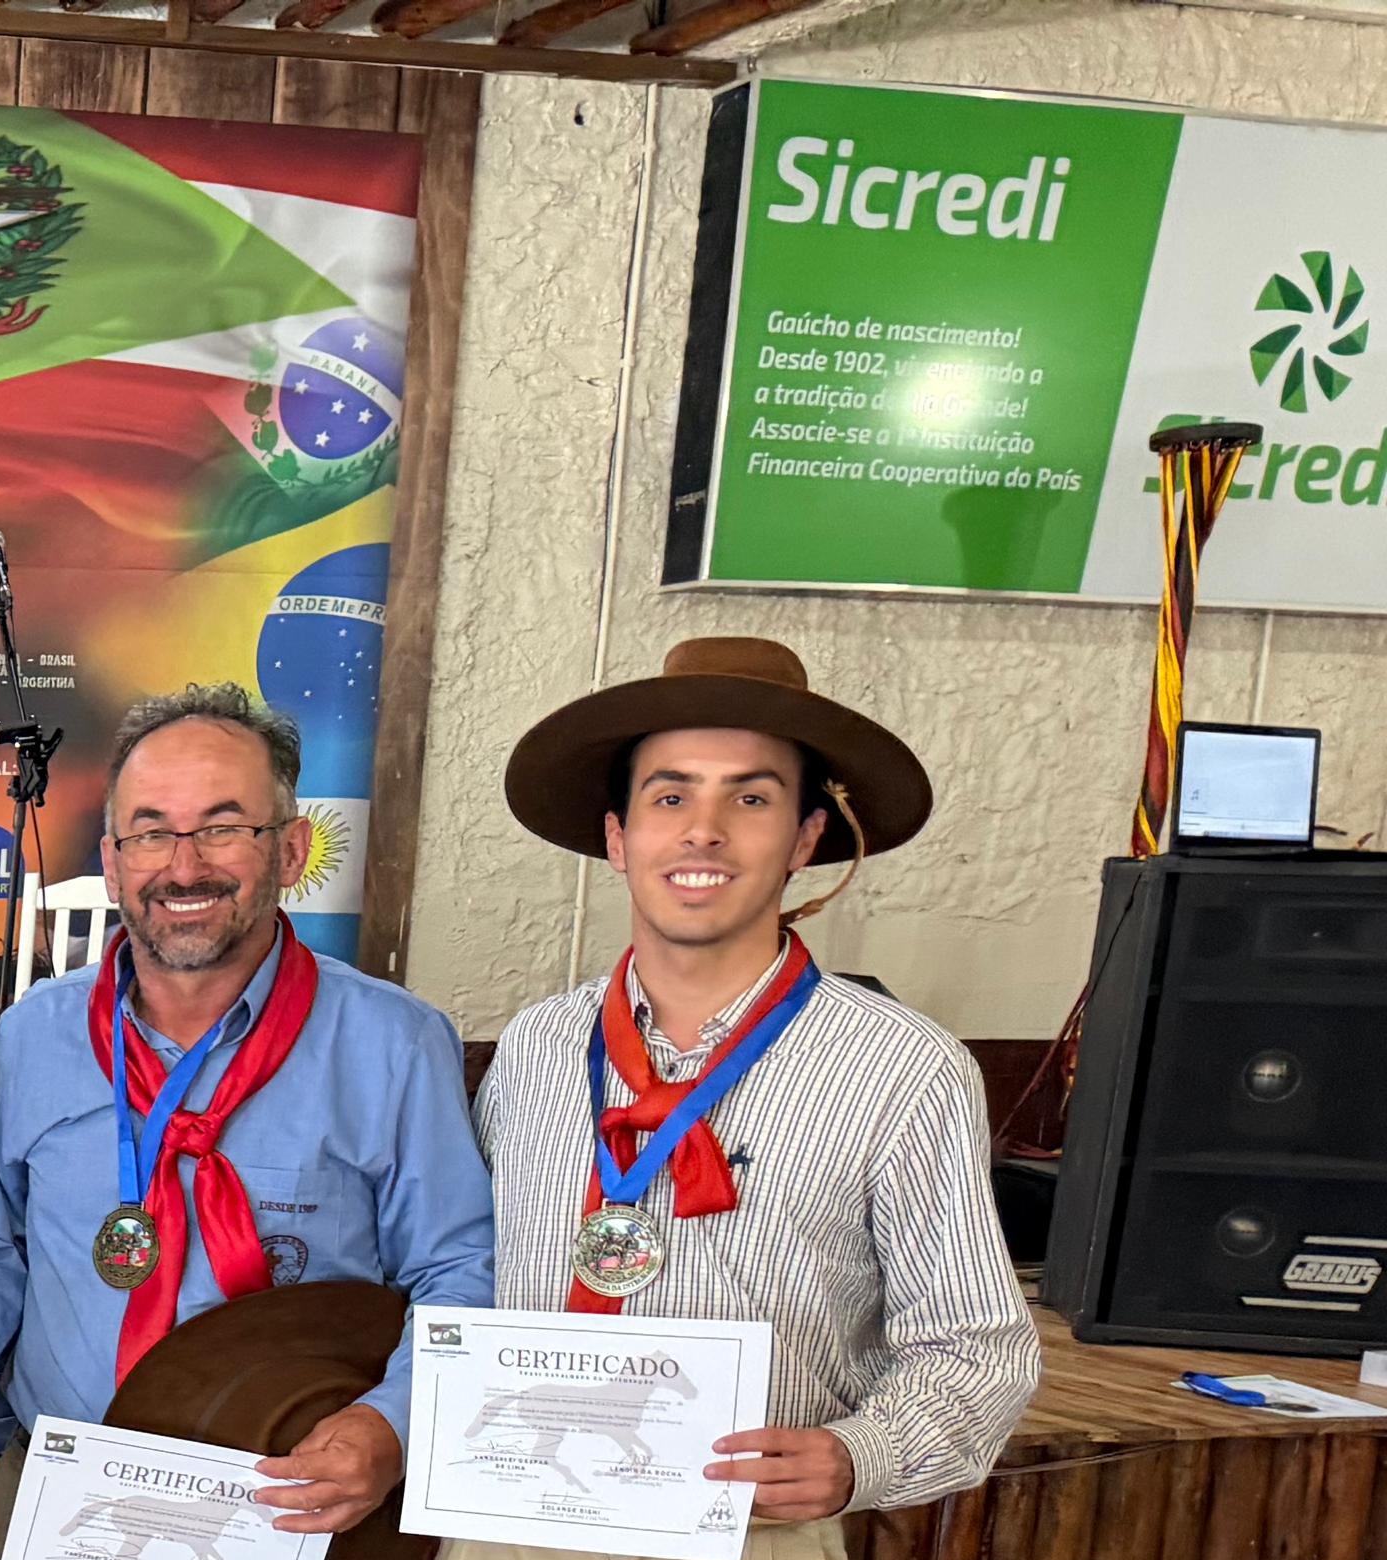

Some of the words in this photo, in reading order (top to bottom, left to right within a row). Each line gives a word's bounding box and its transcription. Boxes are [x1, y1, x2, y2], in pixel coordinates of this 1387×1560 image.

[767, 136, 1072, 242] Sicredi
[767, 310, 850, 339] Gaúcho
[855, 316, 883, 340] de
[886, 321, 1023, 349] nascimento!
[308, 353, 379, 400] PARANÁ
[758, 345, 828, 373] Desde
[833, 350, 889, 379] 1902,
[1029, 368, 1044, 385] a
[754, 387, 769, 405] a
[774, 383, 867, 414] tradição
[749, 416, 871, 447] Associe-se
[876, 428, 891, 446] a
[921, 427, 1035, 459] Instituição
[747, 452, 864, 480] Financeira
[869, 458, 1001, 487] Cooperativa
[1004, 465, 1031, 488] do
[1036, 467, 1083, 492] País
[39, 654, 76, 667] BRASIL
[1283, 1254, 1383, 1294] GRADUS
[497, 1347, 680, 1380] CERTIFICADO
